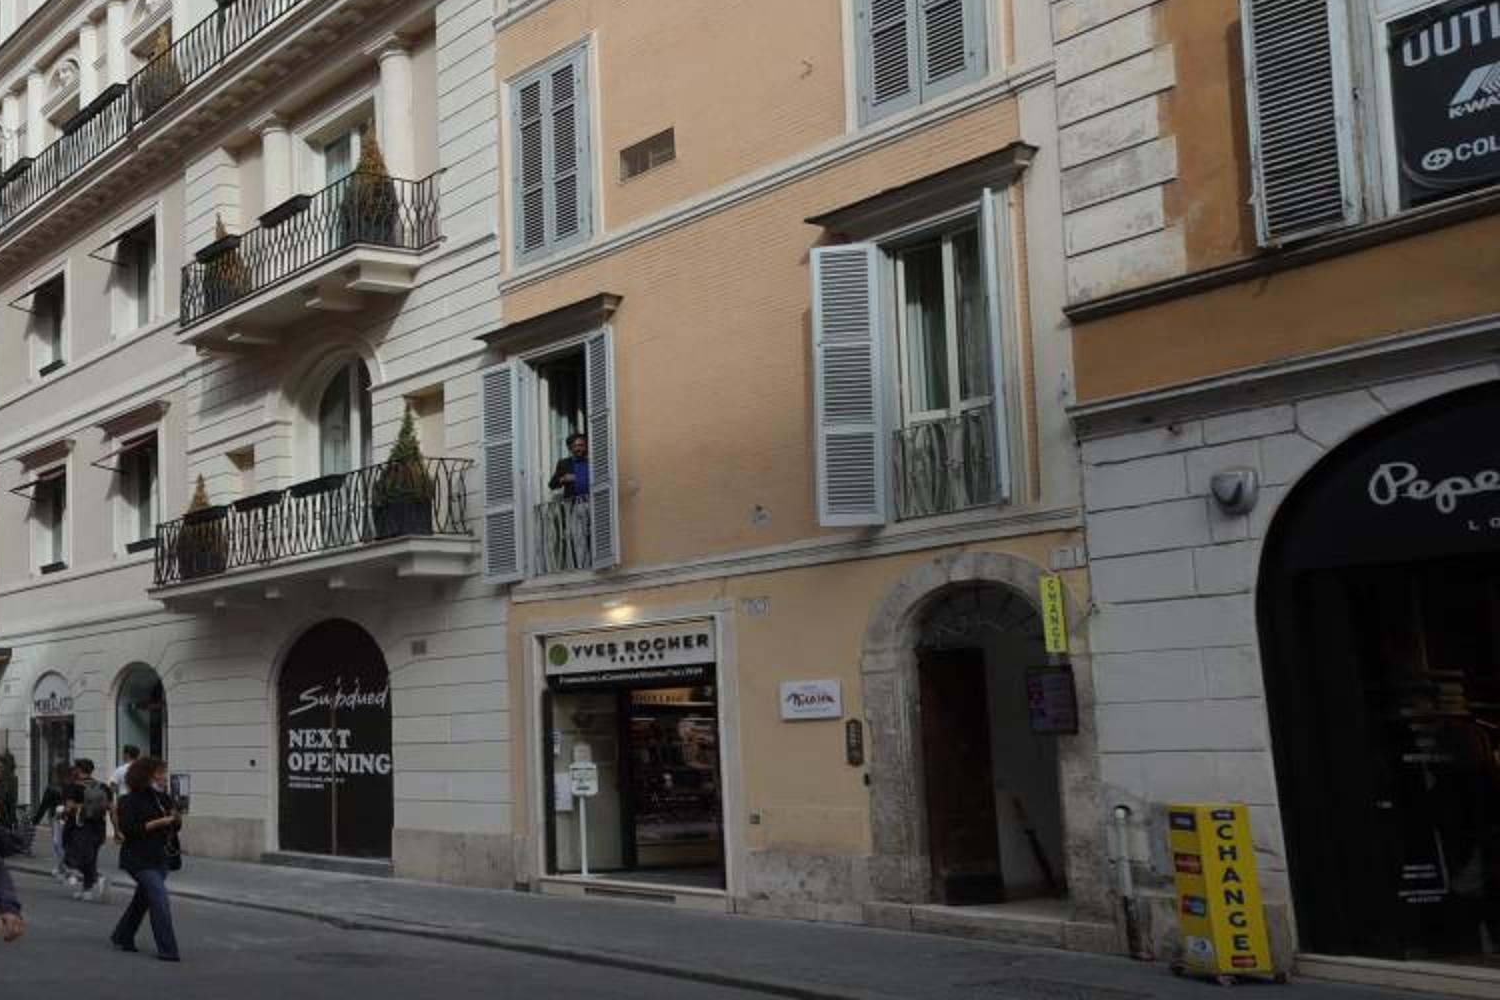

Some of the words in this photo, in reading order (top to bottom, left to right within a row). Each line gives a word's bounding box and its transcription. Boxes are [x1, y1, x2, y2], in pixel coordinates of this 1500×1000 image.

[1367, 461, 1500, 514] Pepe
[1047, 579, 1061, 649] CHANGE
[572, 642, 618, 658] YVES
[624, 633, 709, 653] ROCHER
[287, 676, 390, 716] Subdued
[288, 728, 352, 749] NEXT
[287, 752, 392, 775] OPENING
[1216, 824, 1251, 950] CHANGE
